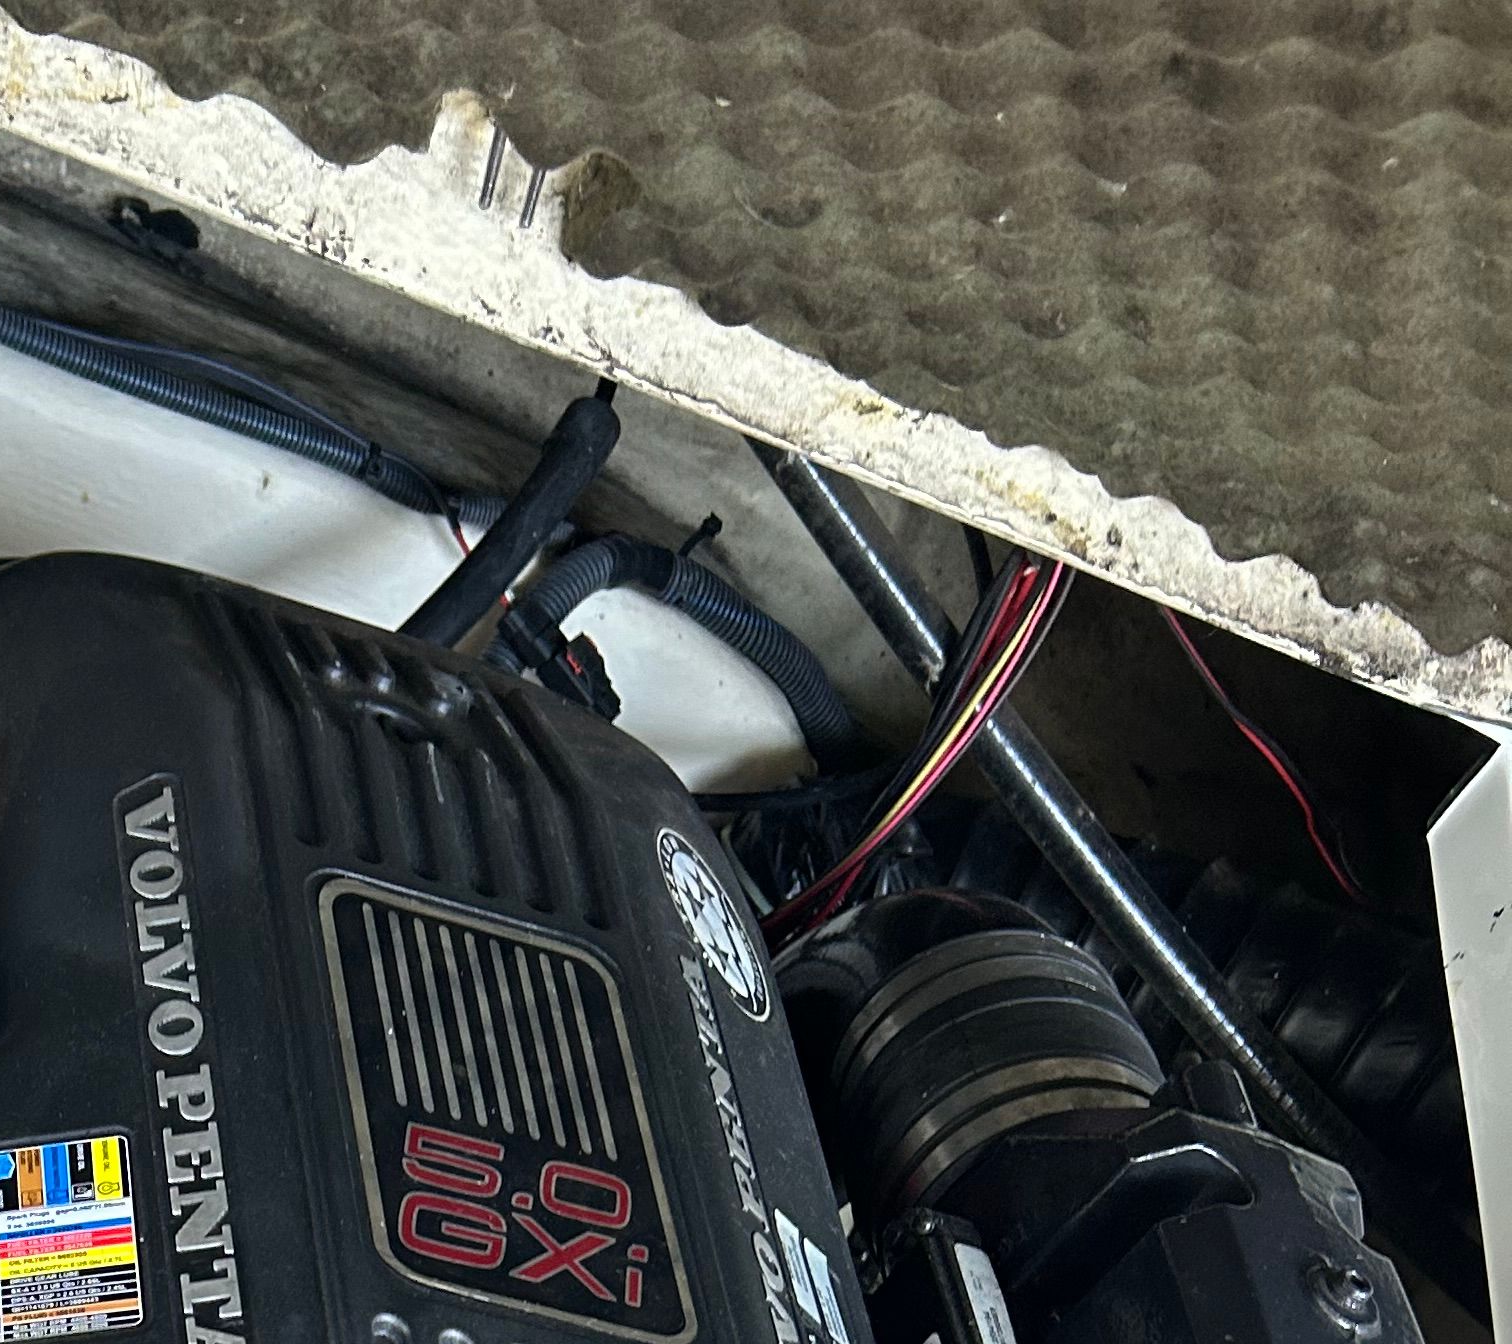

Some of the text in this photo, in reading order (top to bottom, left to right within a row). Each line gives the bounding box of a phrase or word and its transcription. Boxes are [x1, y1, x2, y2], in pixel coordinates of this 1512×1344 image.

[125, 787, 204, 1055] VOLVO
[402, 1121, 632, 1229] 5.0
[679, 954, 770, 1234] PENTA
[398, 1190, 649, 1308] GXi
